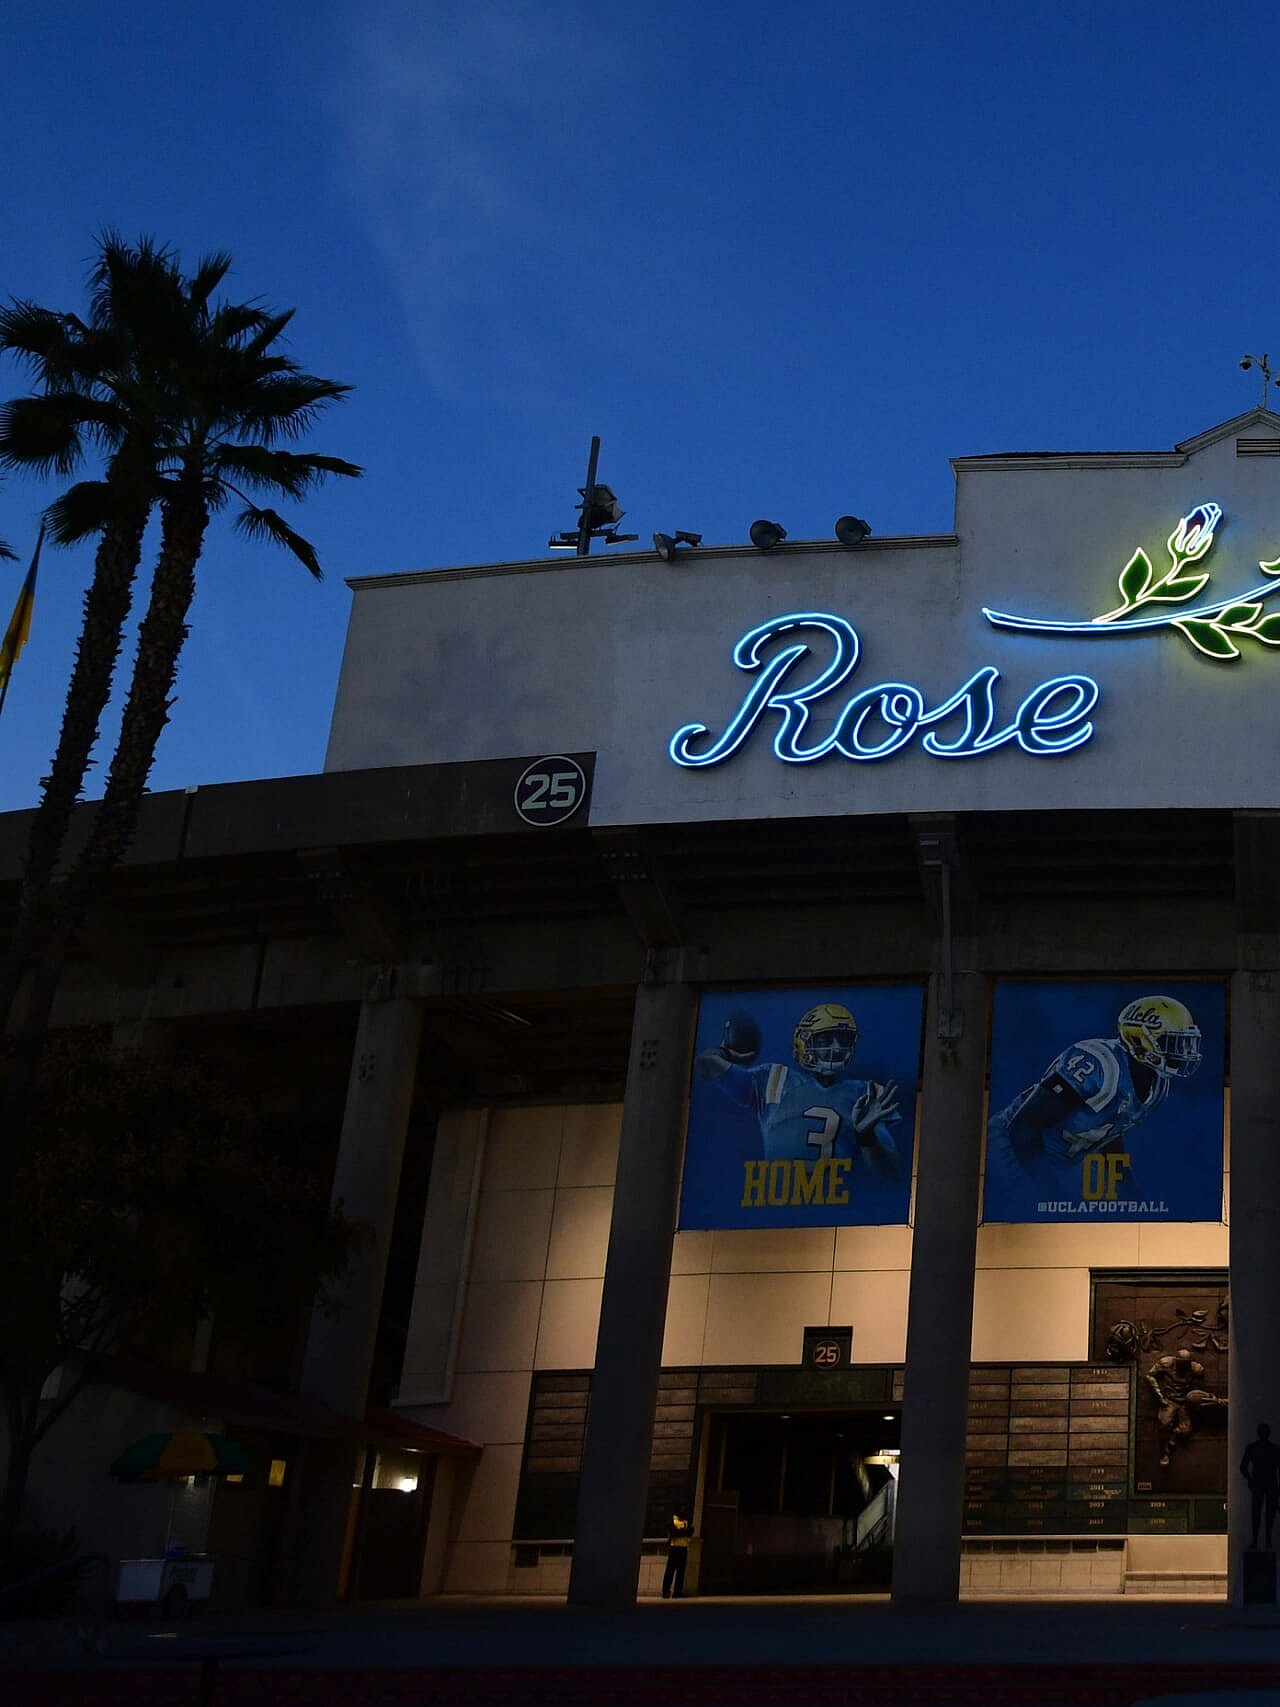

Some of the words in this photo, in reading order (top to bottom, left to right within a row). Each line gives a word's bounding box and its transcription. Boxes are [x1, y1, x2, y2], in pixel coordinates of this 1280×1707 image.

[669, 611, 1100, 768] Rose
[521, 771, 578, 810] 25
[1066, 1054, 1095, 1083] 42
[802, 1105, 841, 1162] 3
[741, 1158, 853, 1207] HOME
[1081, 1153, 1131, 1201] OF
[1037, 1201, 1169, 1213] @UCLAFOOTBALL
[815, 1346, 838, 1363] 25
